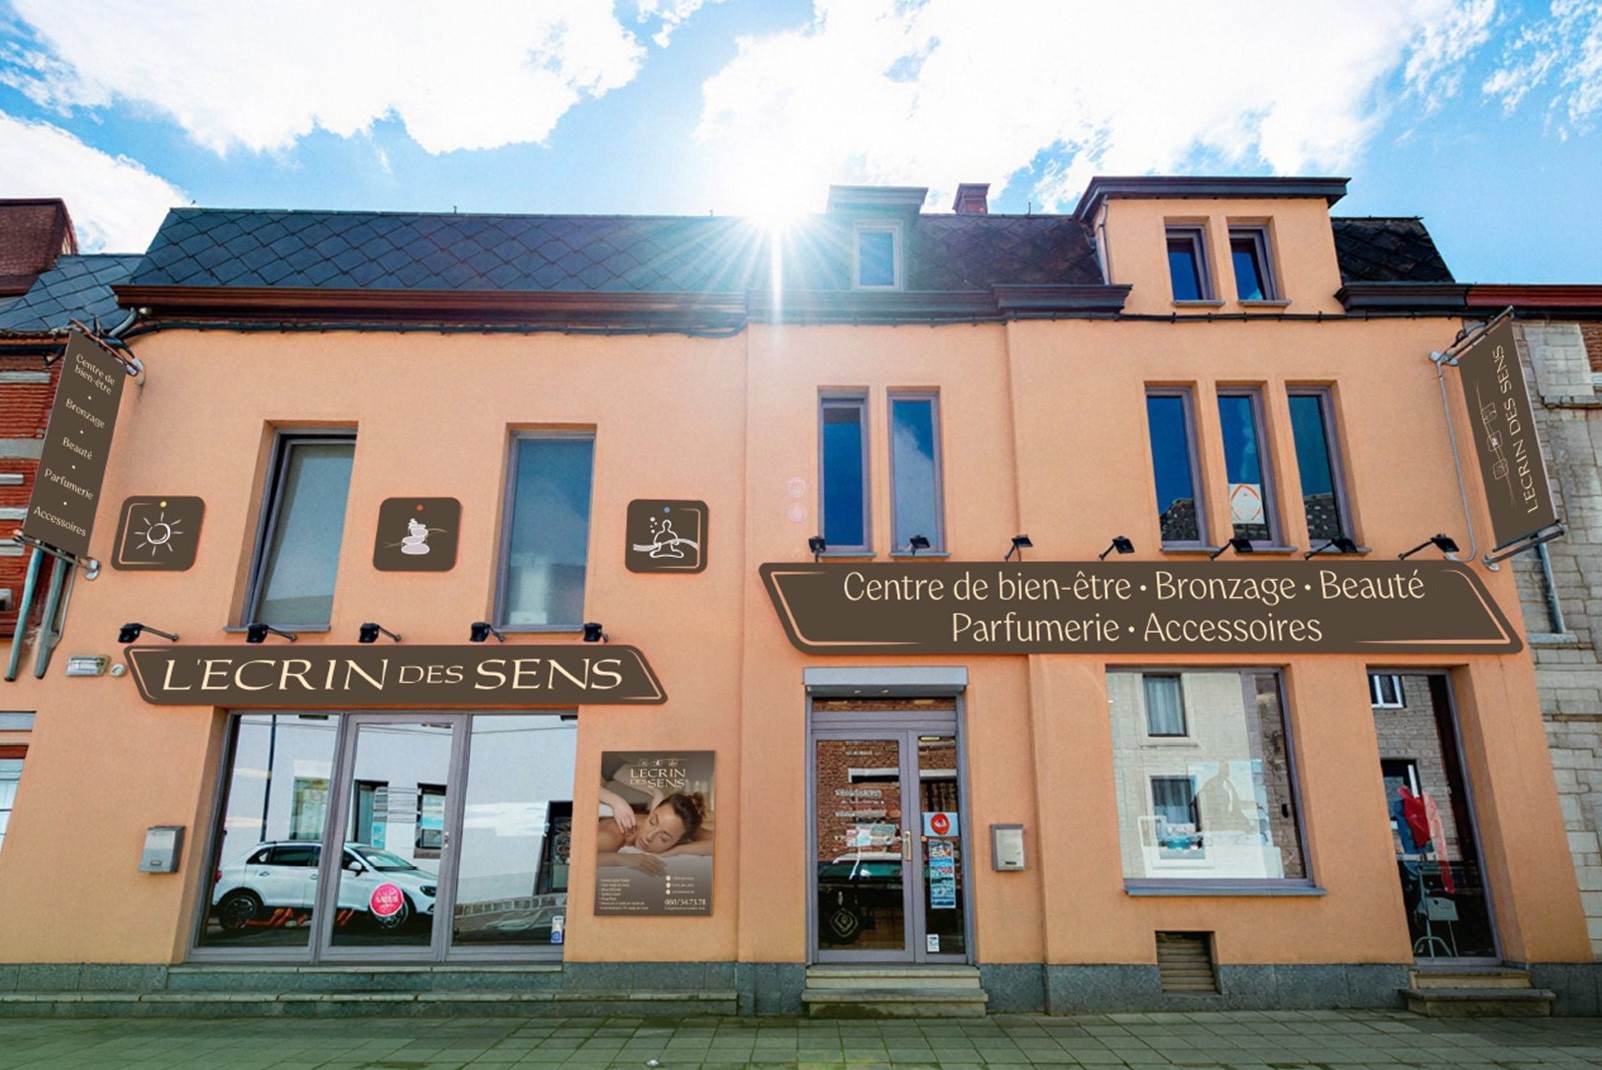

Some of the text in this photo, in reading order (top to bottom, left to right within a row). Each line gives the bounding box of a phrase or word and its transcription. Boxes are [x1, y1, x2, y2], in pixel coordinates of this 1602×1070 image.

[74, 364, 112, 395] bien-être
[75, 353, 115, 386] Centre de
[65, 398, 105, 428] Bronzage
[1493, 345, 1539, 514] L'ECRIN DES SENS
[62, 436, 93, 460] Beauté
[44, 468, 94, 501] Parfumerie
[33, 506, 87, 537] Accessoires
[843, 568, 1425, 605] Centre de bien-être Bronzage Beauté
[952, 611, 1323, 642] Parfumerie Accessoires
[162, 658, 623, 691] L'ECRIN DES SENS
